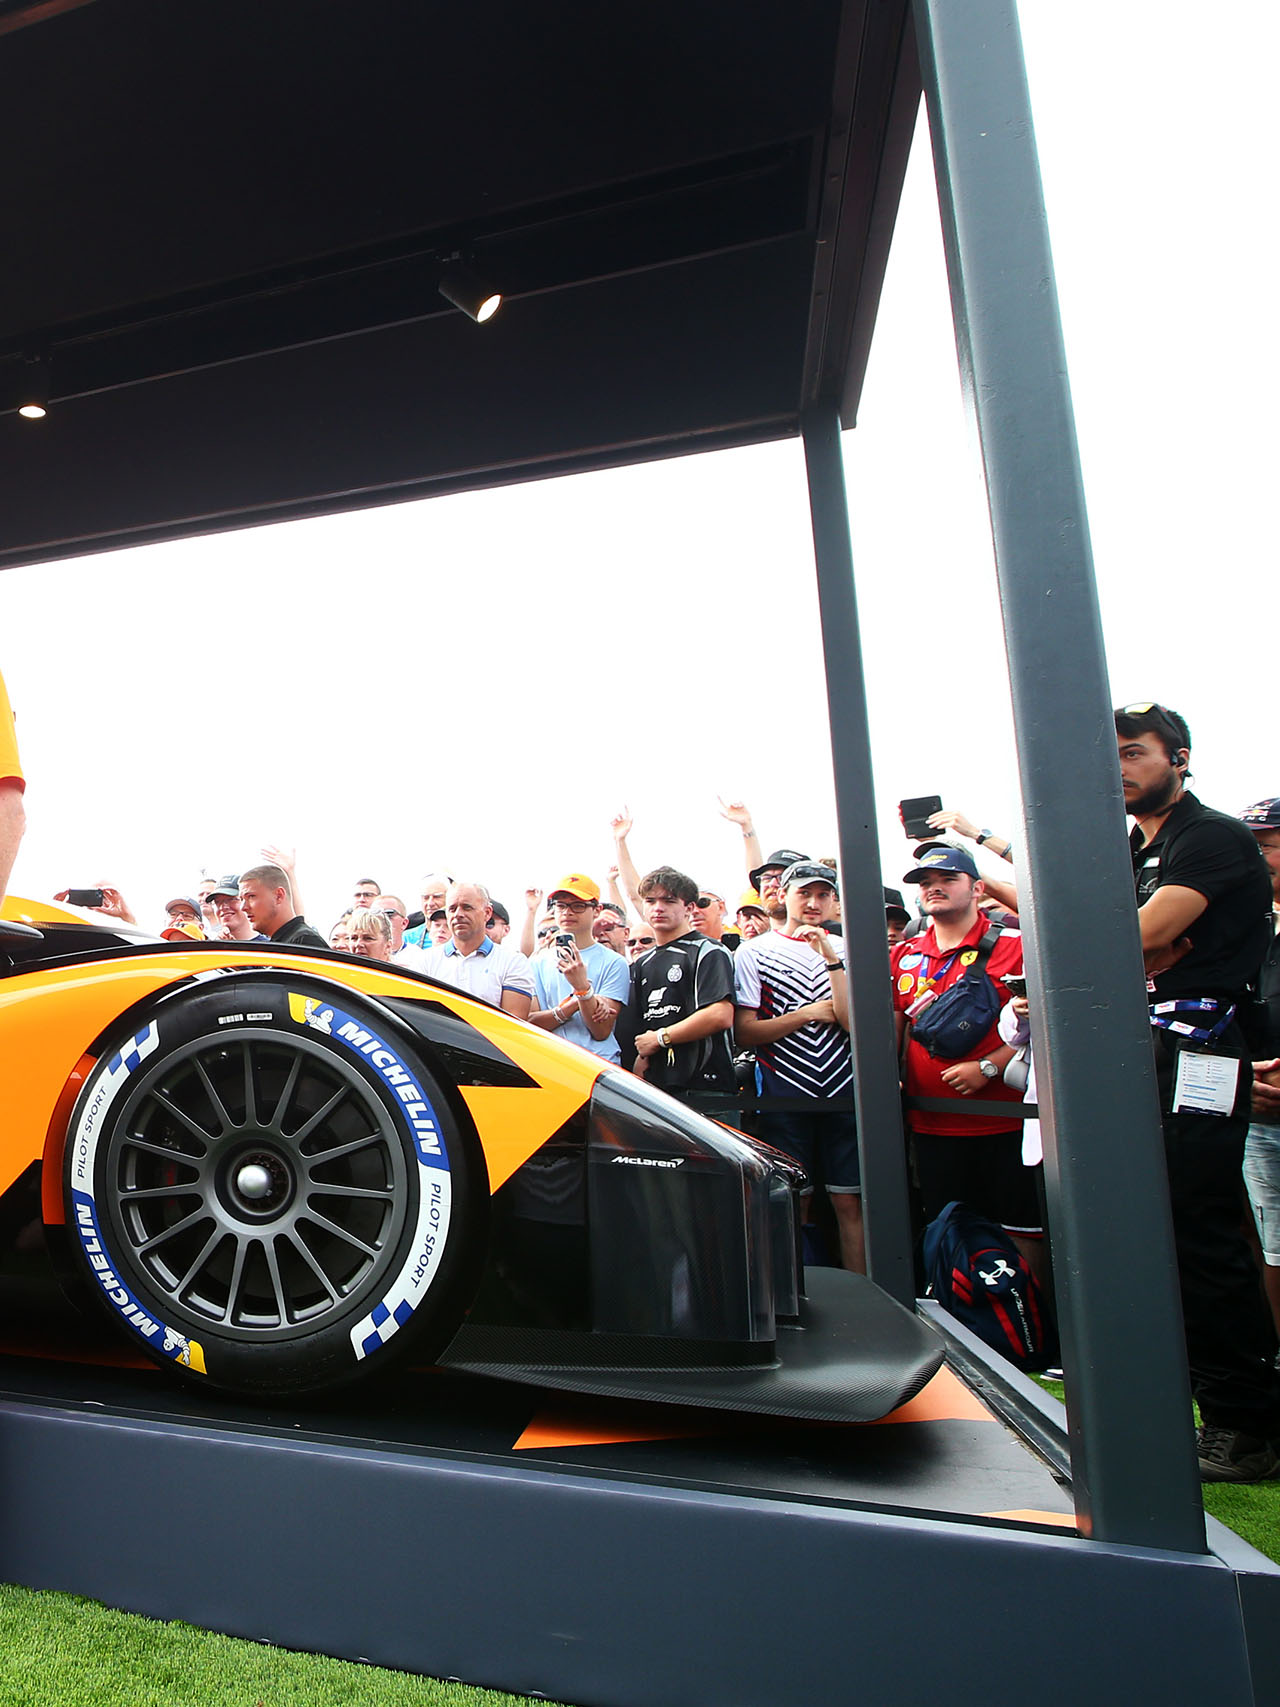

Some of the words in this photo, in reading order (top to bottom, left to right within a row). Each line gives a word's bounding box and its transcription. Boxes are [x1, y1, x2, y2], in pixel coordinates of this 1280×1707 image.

[336, 1021, 442, 1156] MICHELIN
[77, 1135, 89, 1179] PILOT
[85, 1086, 107, 1133] SPORT
[611, 1156, 677, 1168] McLaren
[428, 1183, 441, 1232] PILOT
[76, 1203, 160, 1337] MICHELIN
[410, 1234, 436, 1288] SPORT
